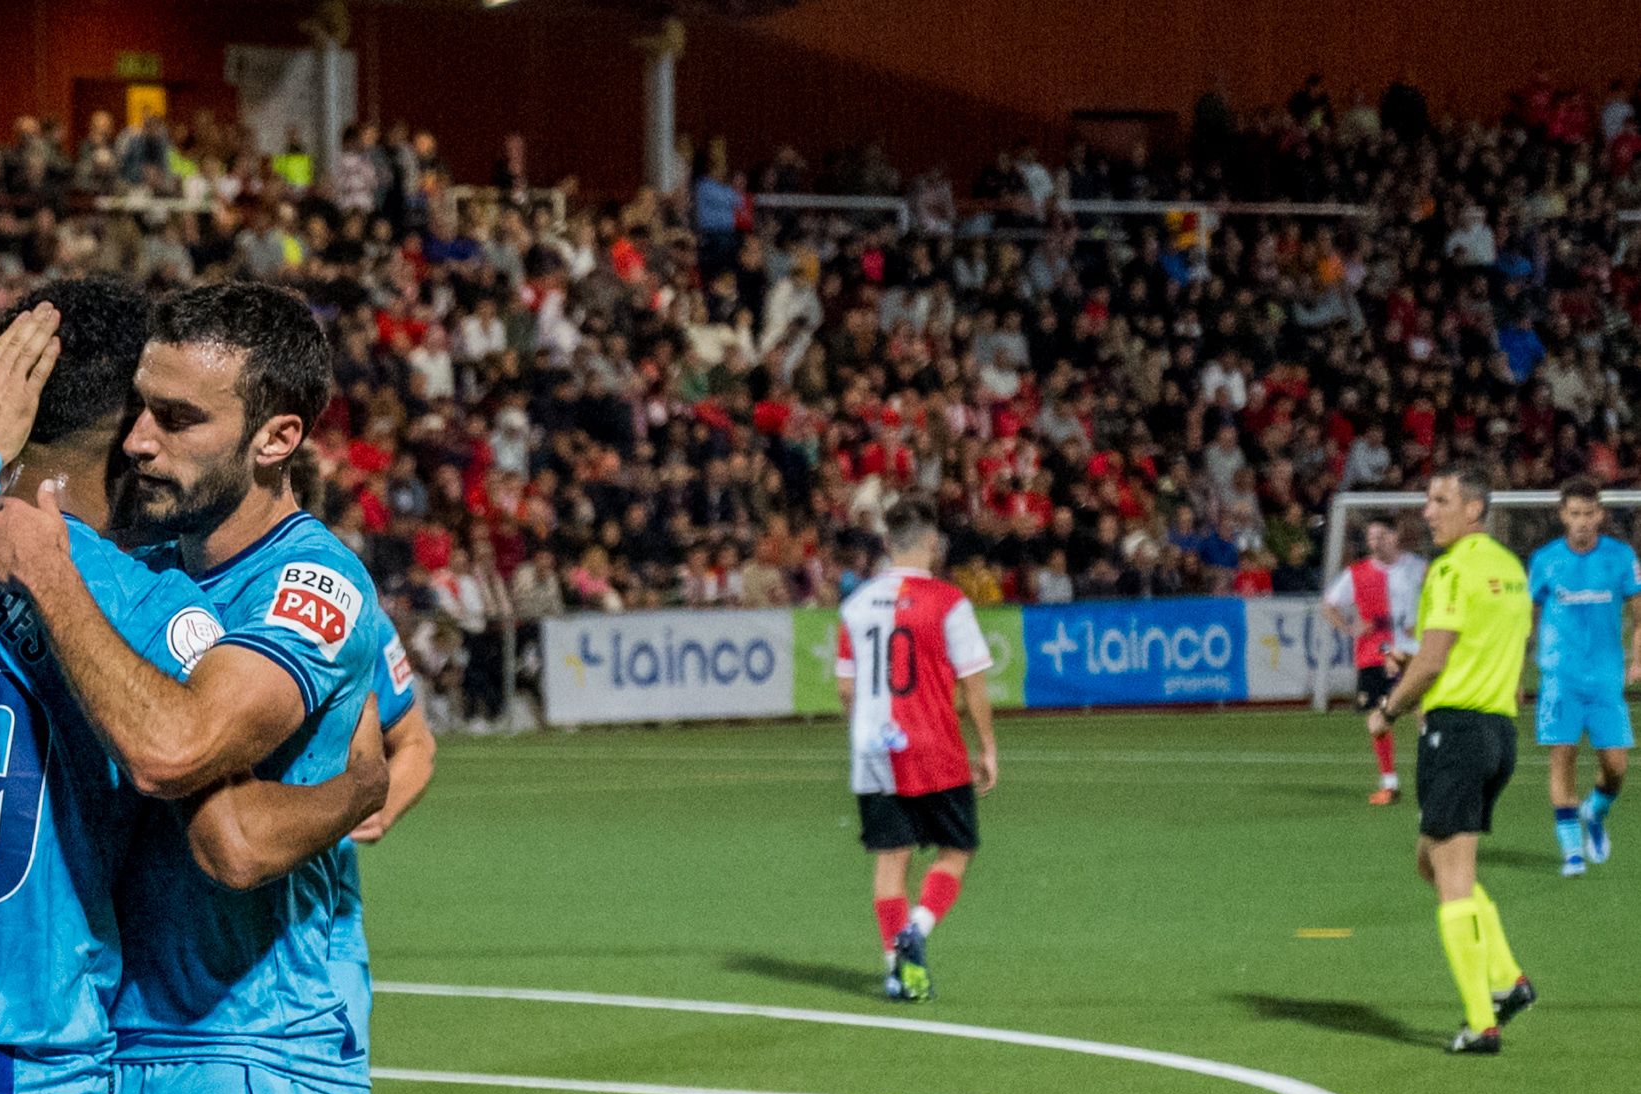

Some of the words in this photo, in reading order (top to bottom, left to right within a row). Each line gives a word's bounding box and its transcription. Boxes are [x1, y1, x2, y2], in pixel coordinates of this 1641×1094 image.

[282, 592, 336, 630] PAY
[284, 568, 352, 610] B2Bin
[611, 624, 776, 690] lainco
[866, 624, 917, 697] 10
[1086, 612, 1233, 675] lainco
